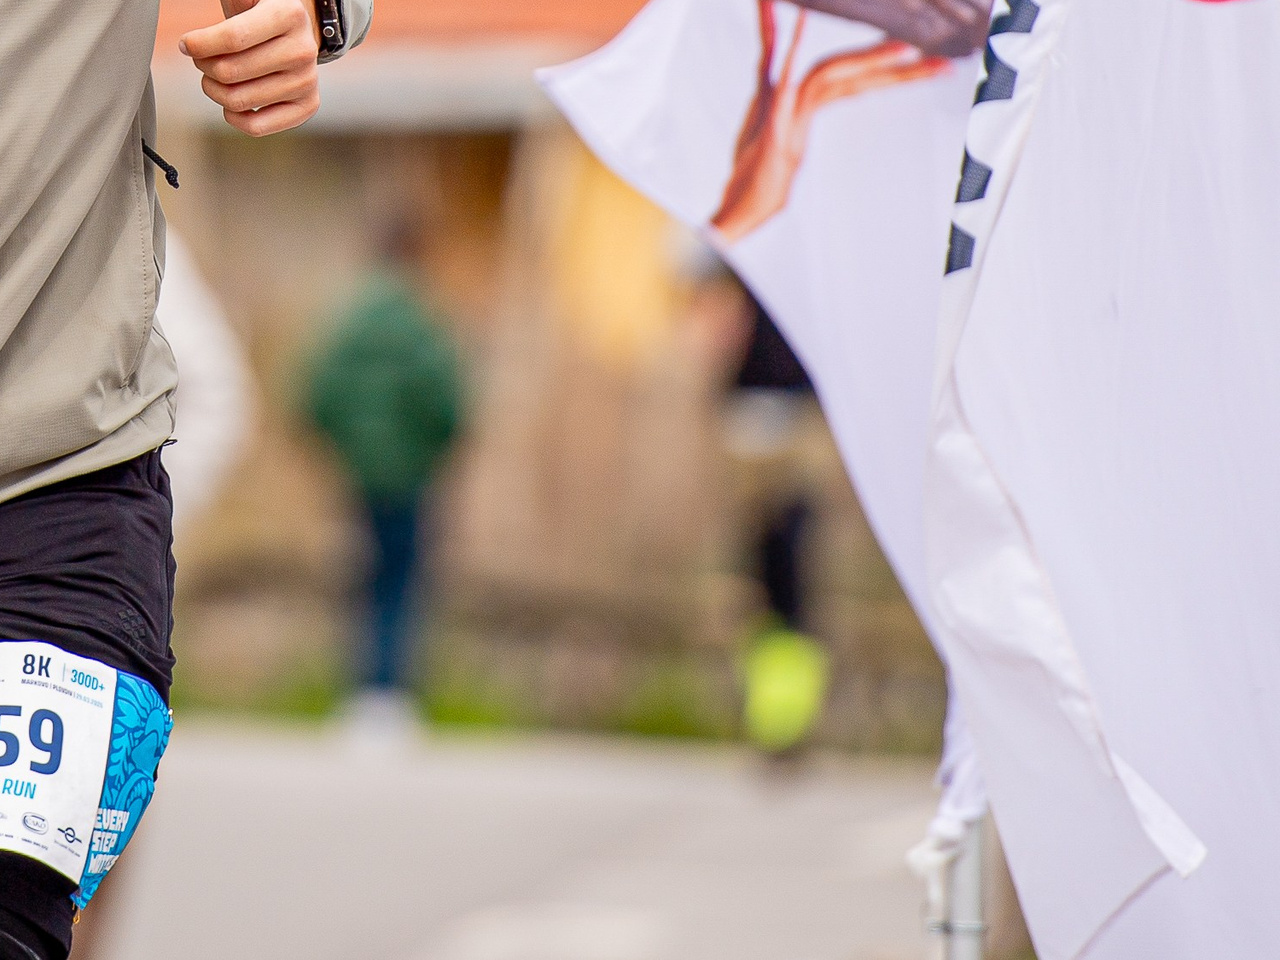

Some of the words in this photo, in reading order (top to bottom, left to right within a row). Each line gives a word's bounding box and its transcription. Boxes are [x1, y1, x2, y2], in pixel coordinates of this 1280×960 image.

[22, 653, 52, 678] 8K
[2, 777, 37, 800] RUN
[91, 830, 118, 853] STEP
